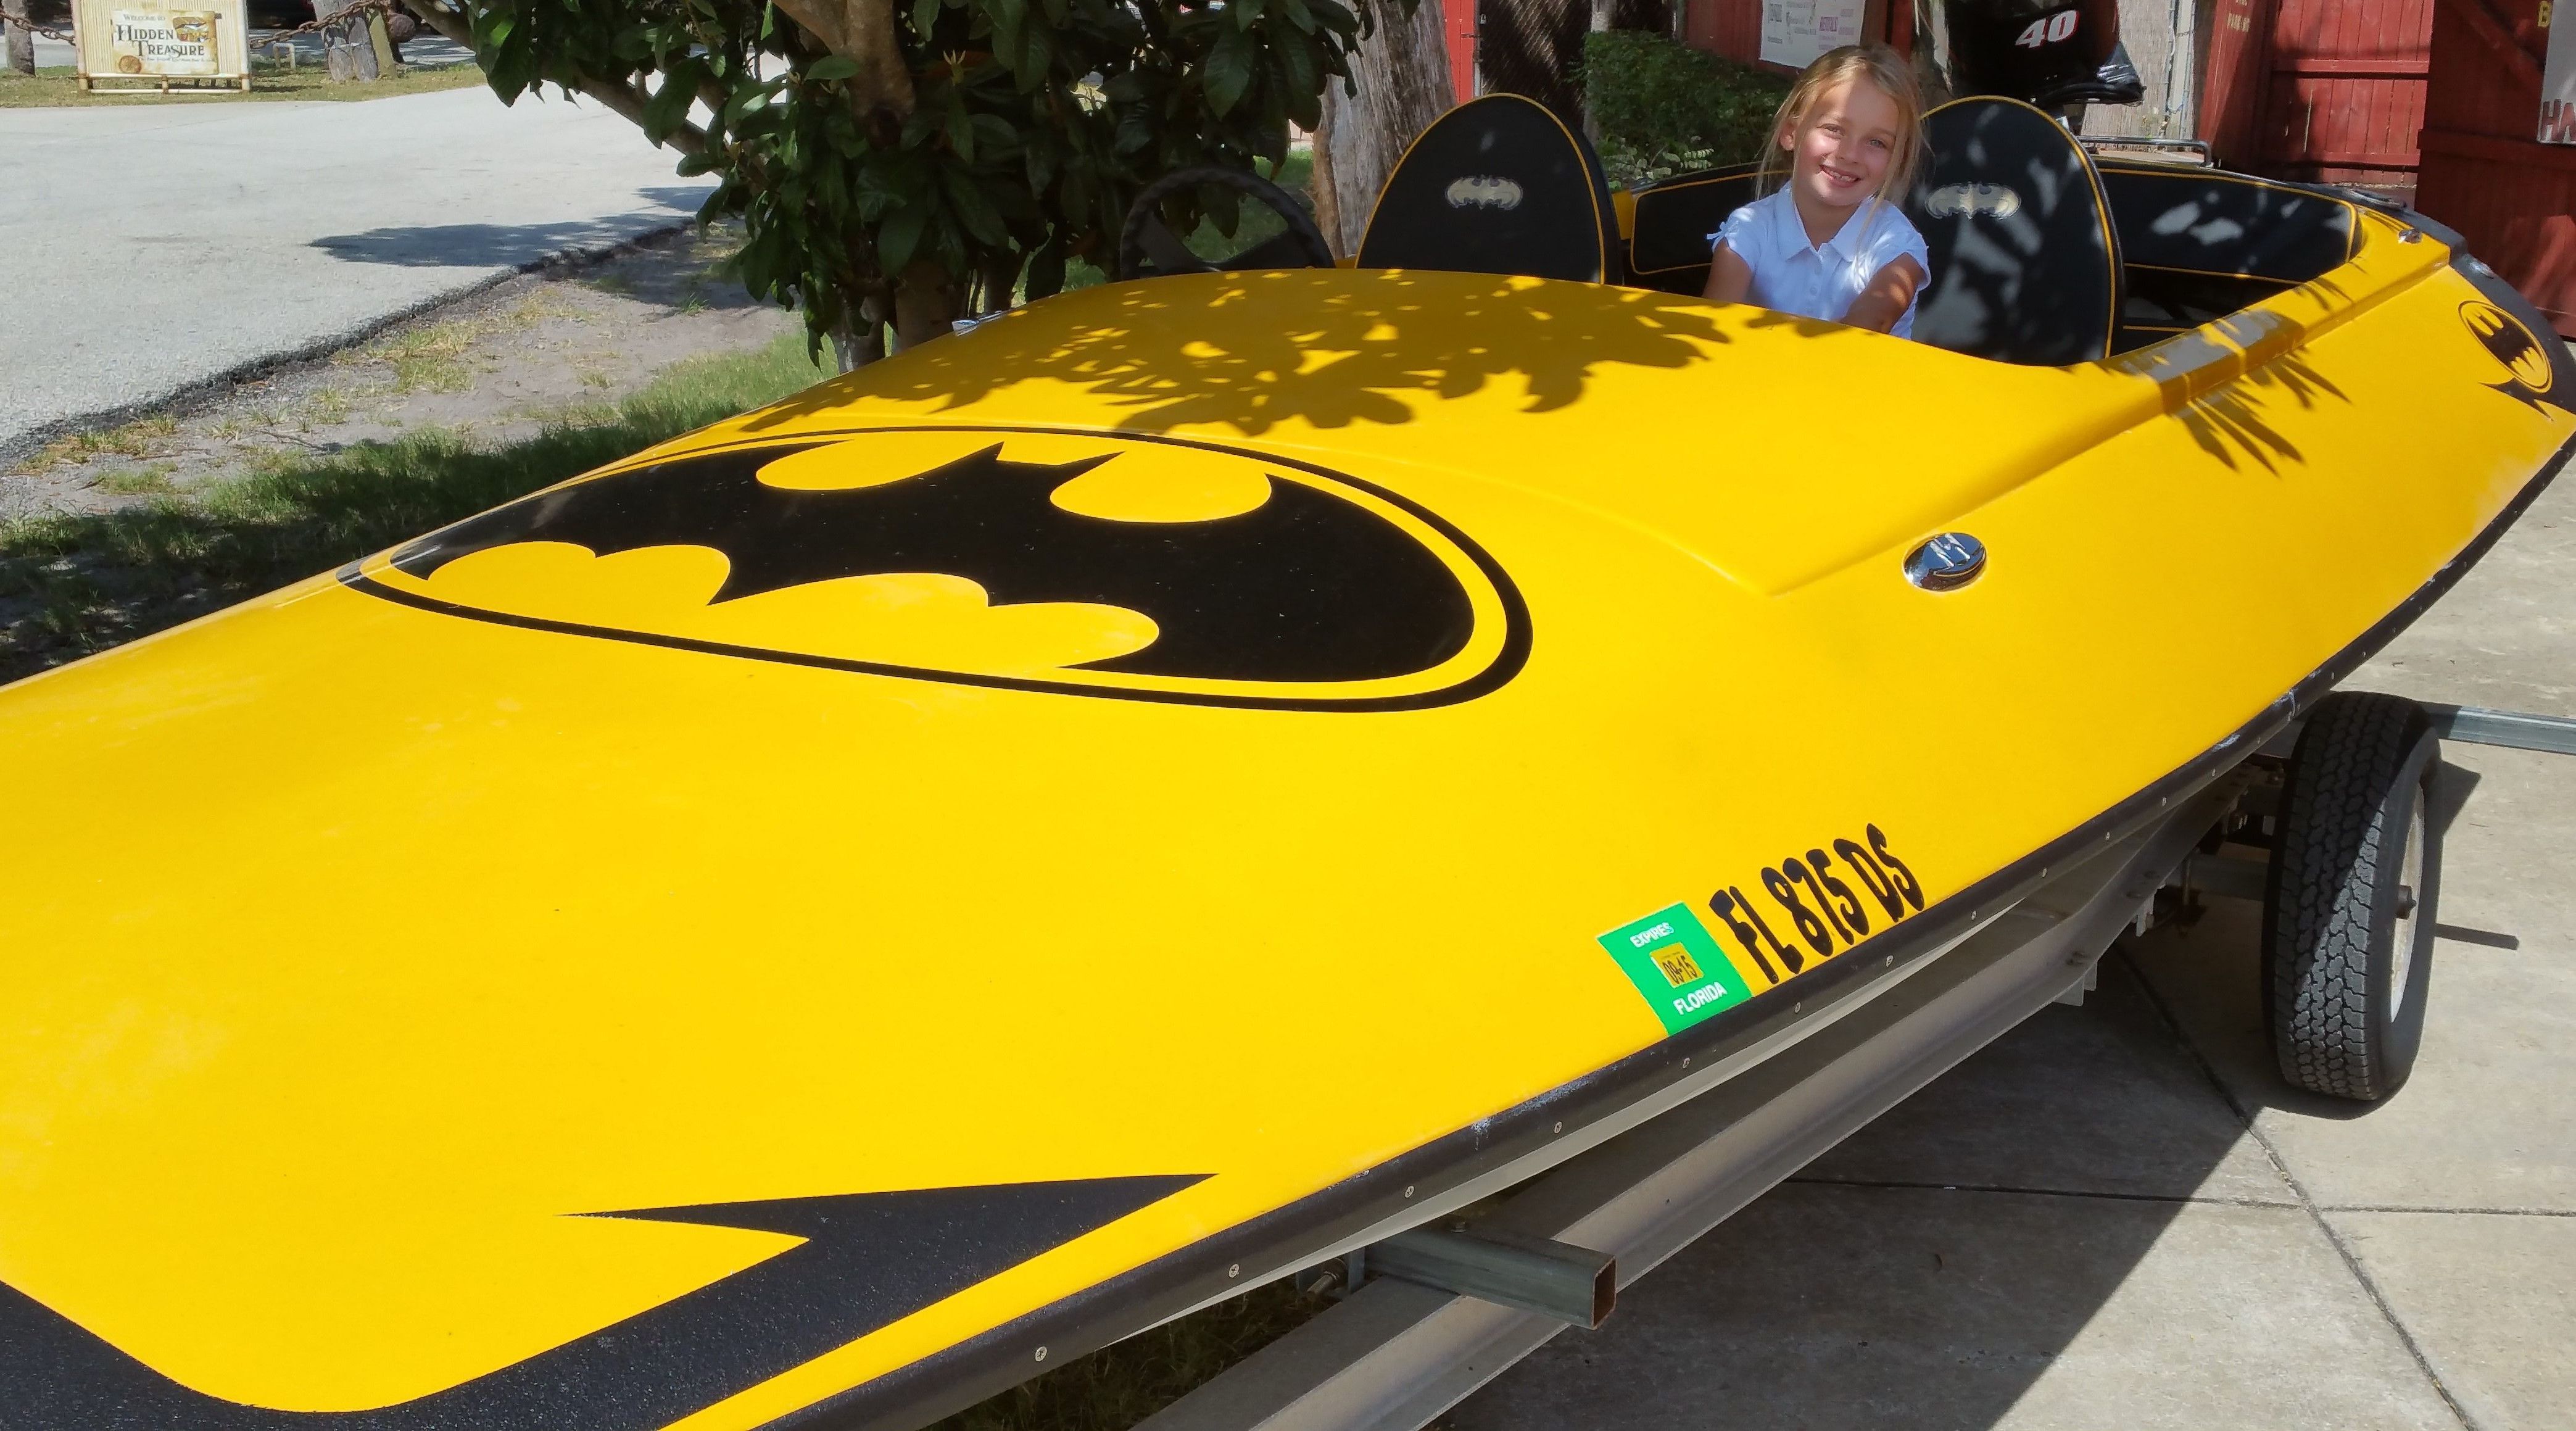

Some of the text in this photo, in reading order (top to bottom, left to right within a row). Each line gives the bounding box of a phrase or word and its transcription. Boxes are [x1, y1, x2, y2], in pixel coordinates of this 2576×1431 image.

[115, 24, 174, 41] HIDDEN
[2015, 9, 2080, 49] 40
[131, 40, 205, 59] TREASURE
[1708, 823, 1925, 985] FL 875 DS
[1630, 922, 1675, 948] EXPIRES
[1673, 981, 1728, 1016] FLORIDA
